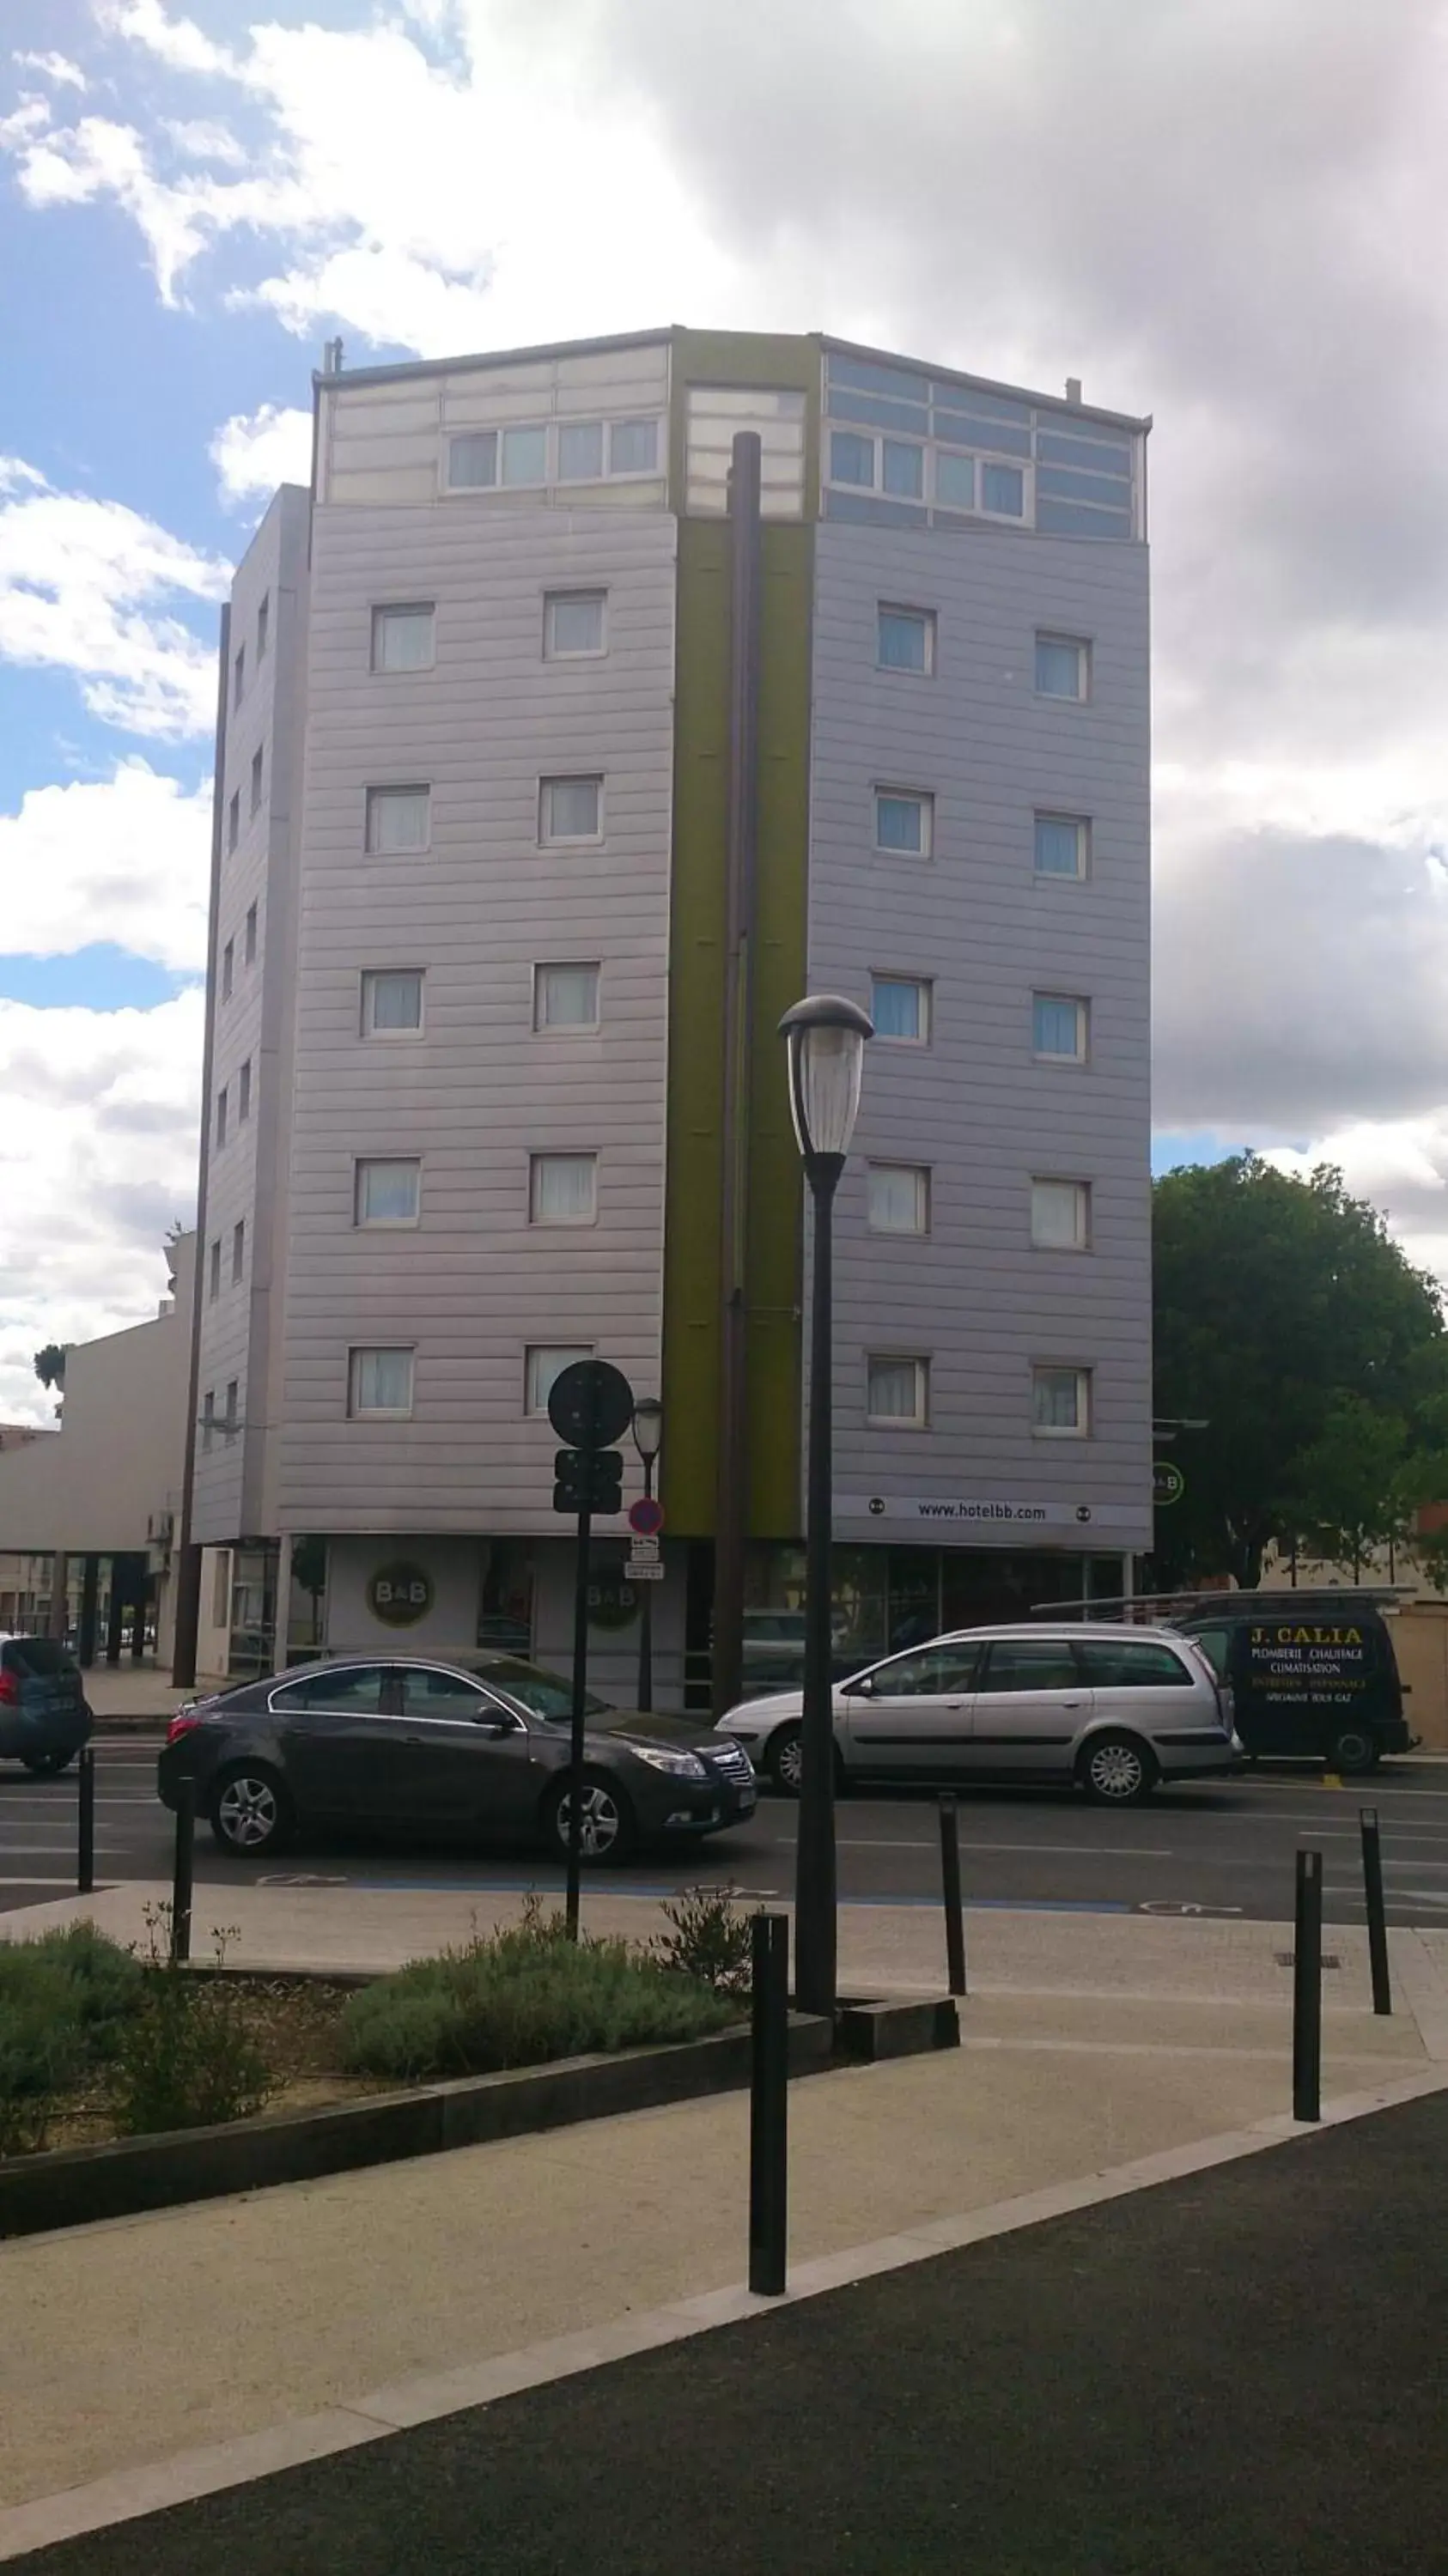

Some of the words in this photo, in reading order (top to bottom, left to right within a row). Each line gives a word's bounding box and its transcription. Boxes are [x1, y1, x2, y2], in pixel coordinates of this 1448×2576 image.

[918, 1503, 1046, 1520] www.hotelbb.com
[376, 1581, 427, 1603] B&B
[587, 1585, 636, 1607] B&B
[1250, 1627, 1271, 1643] J.
[1277, 1626, 1363, 1643] CALIA
[1251, 1648, 1302, 1660] PLOMBERIE
[1310, 1649, 1363, 1661] CHAUFFAGE
[1270, 1662, 1341, 1674] CLIMATISATION
